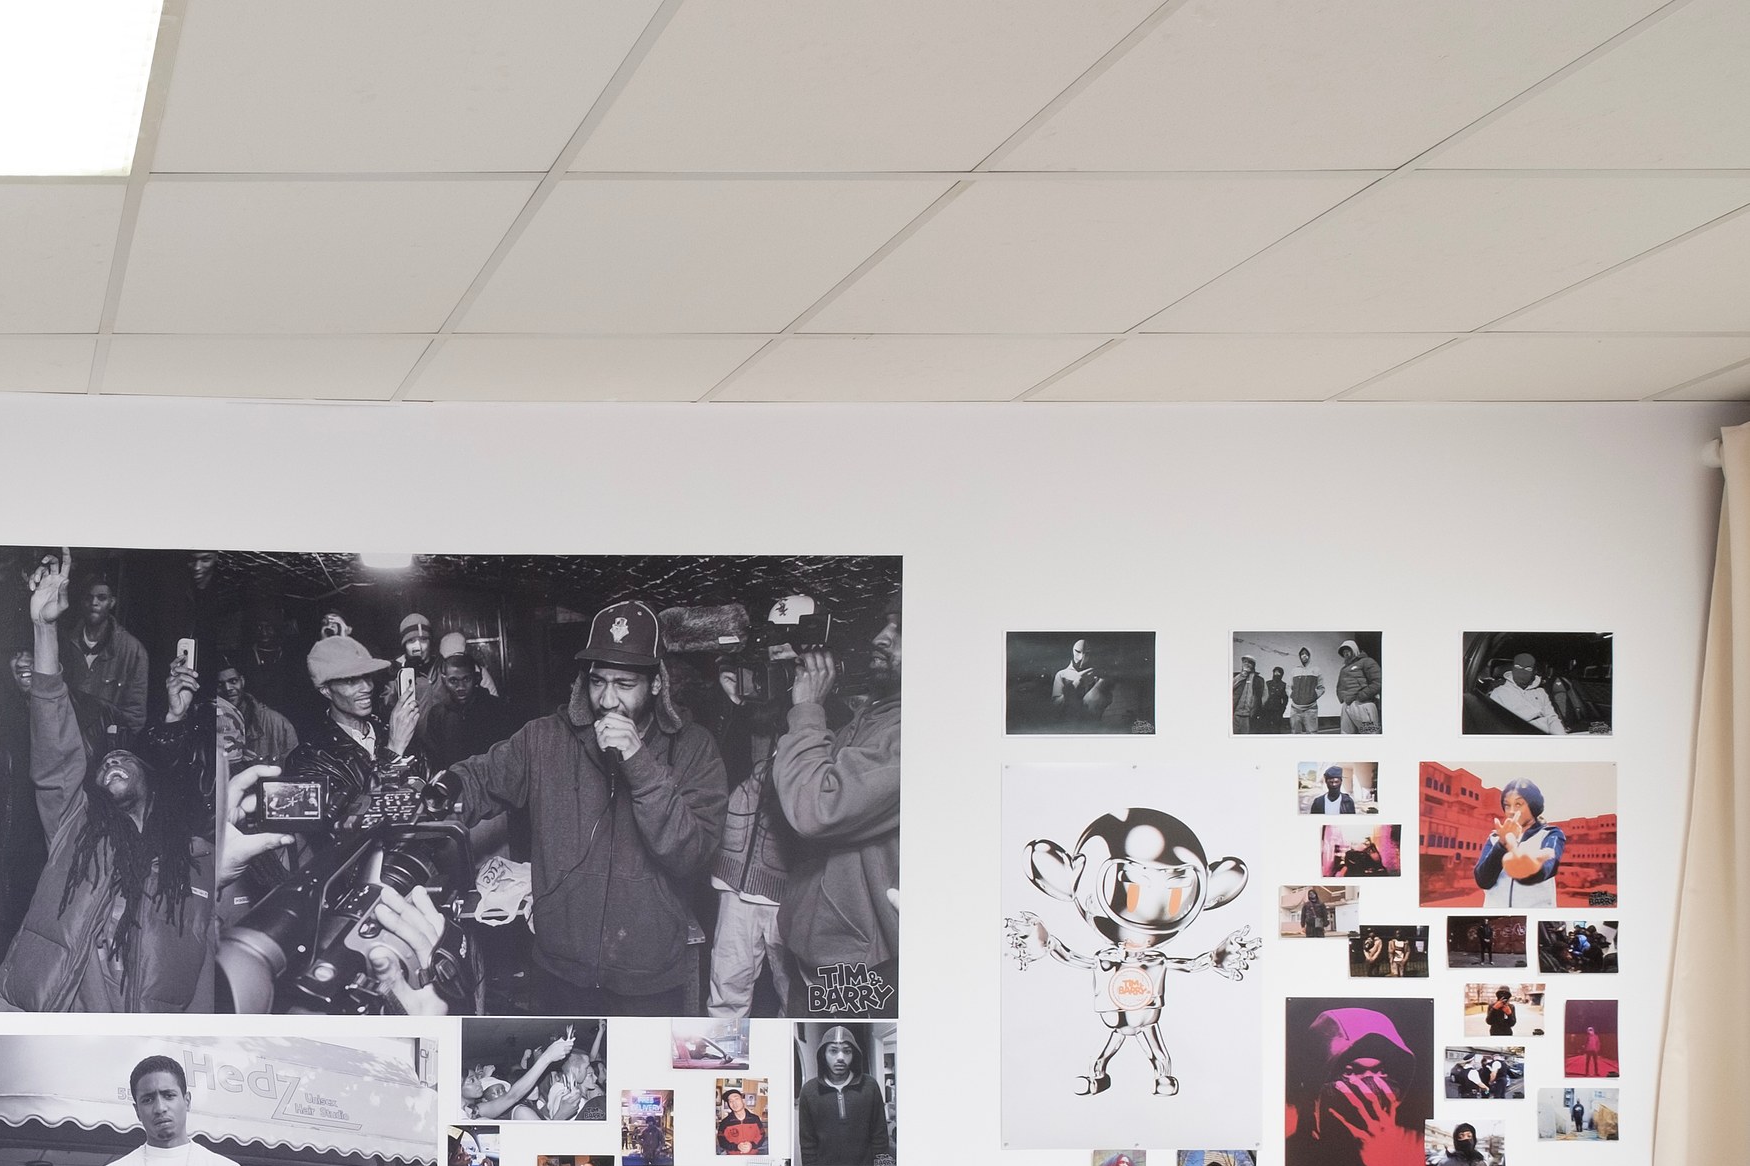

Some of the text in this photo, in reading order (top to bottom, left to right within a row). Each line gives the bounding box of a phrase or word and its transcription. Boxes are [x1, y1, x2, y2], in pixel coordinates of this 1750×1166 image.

[807, 983, 895, 1014] BARRY
[294, 1103, 351, 1122] Hair Studio
